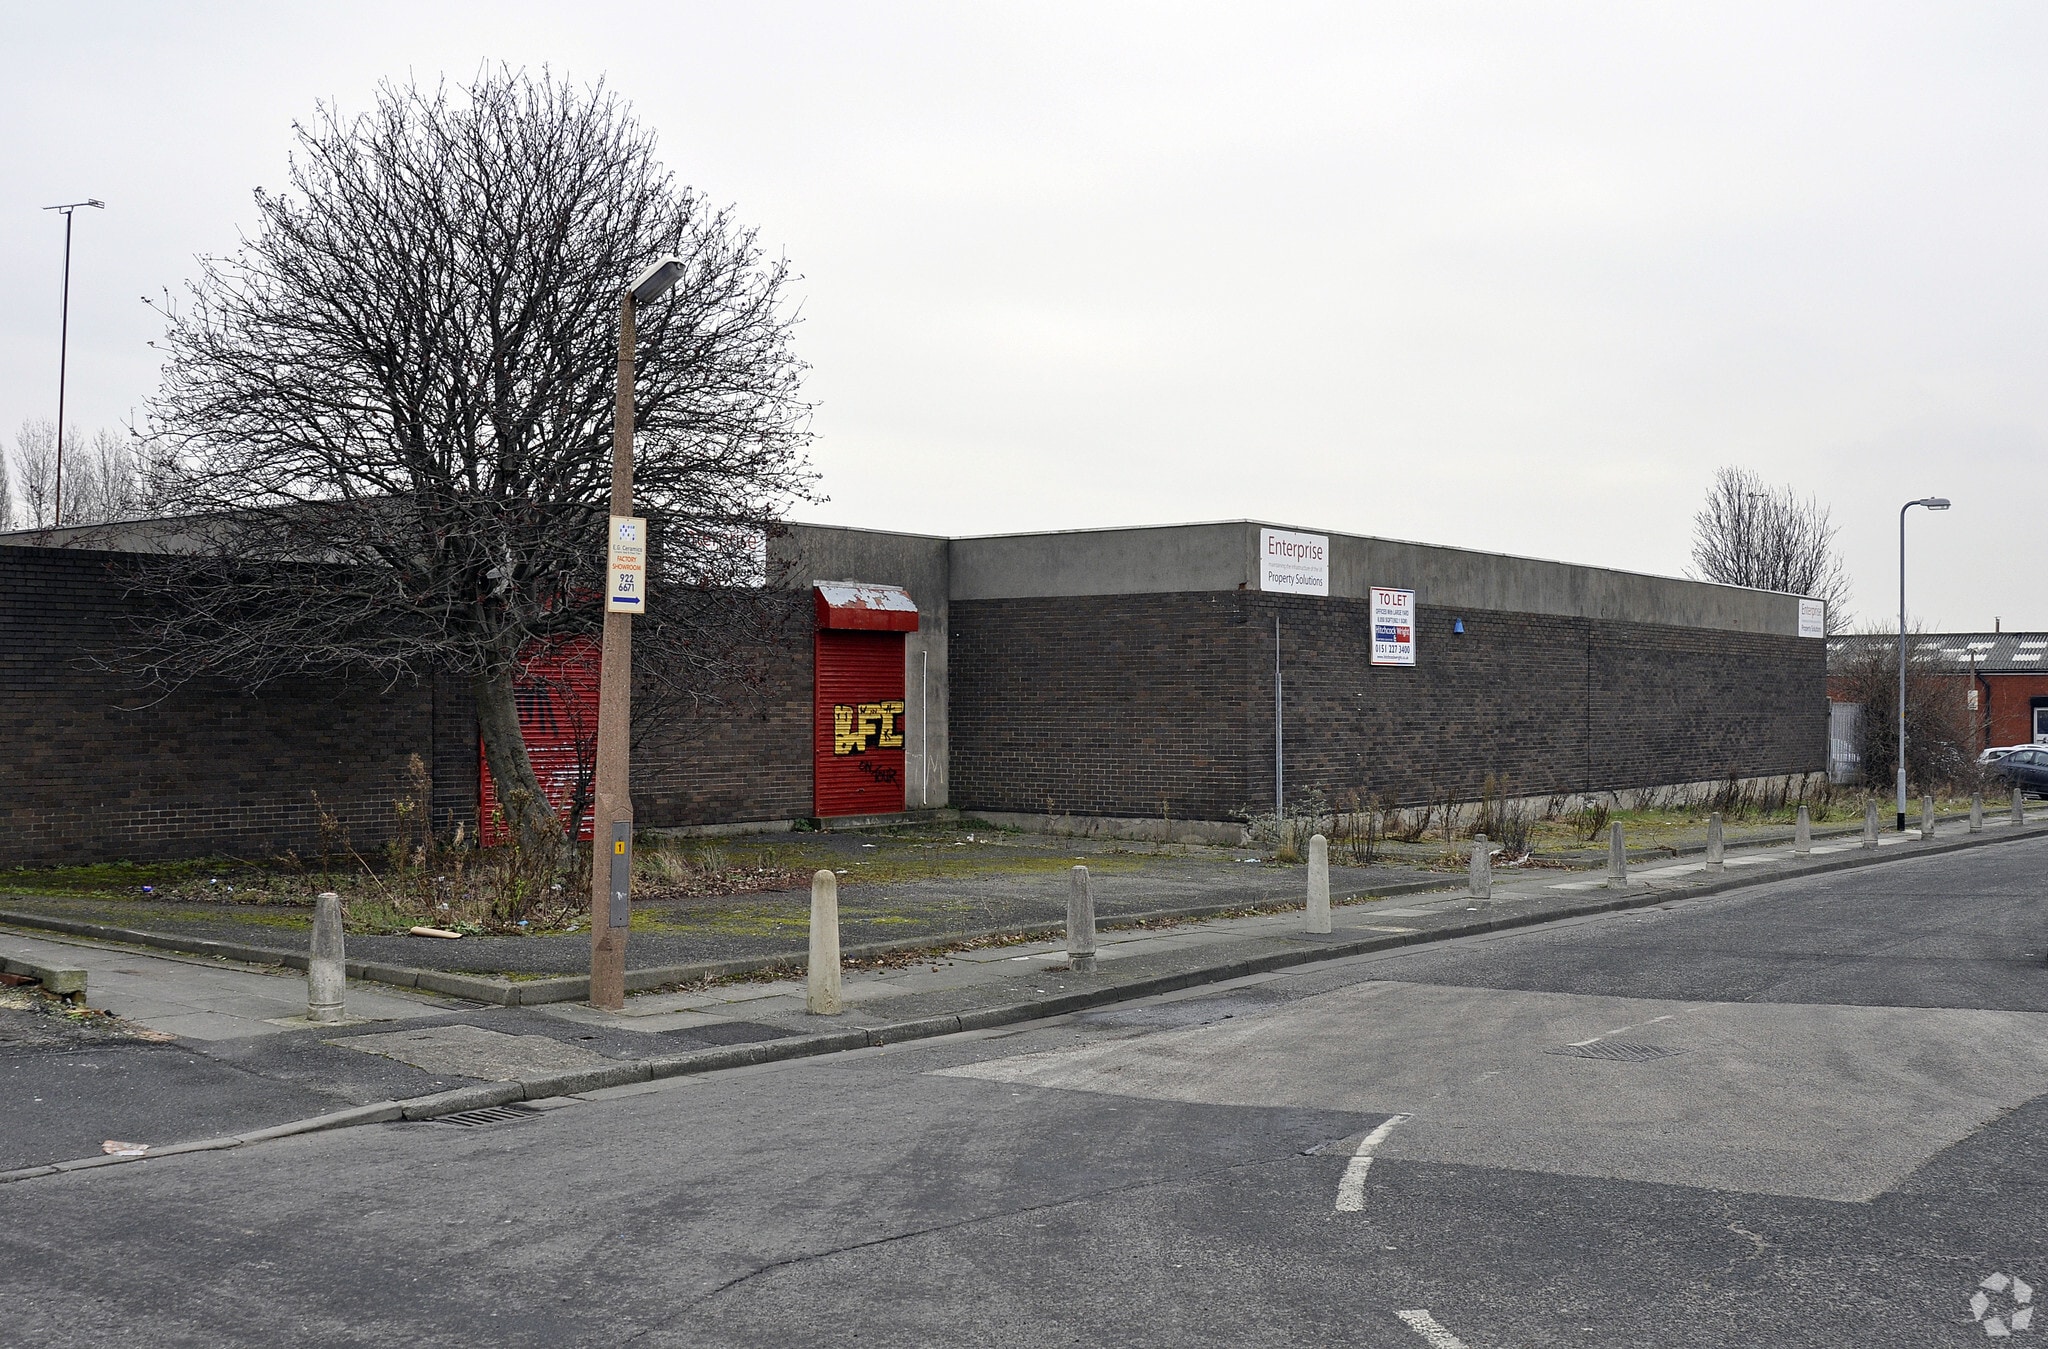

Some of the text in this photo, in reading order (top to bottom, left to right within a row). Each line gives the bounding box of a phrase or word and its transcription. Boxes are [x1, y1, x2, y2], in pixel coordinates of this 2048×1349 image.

[1269, 536, 1323, 562] Enterprise
[619, 574, 634, 583] 922
[1268, 571, 1323, 587] Property Solutions
[618, 583, 634, 592] 6671
[1379, 593, 1407, 606] TO LET
[1802, 603, 1822, 618] Enterprise
[1375, 644, 1410, 654] 0151 227 3400
[618, 844, 622, 852] 1
